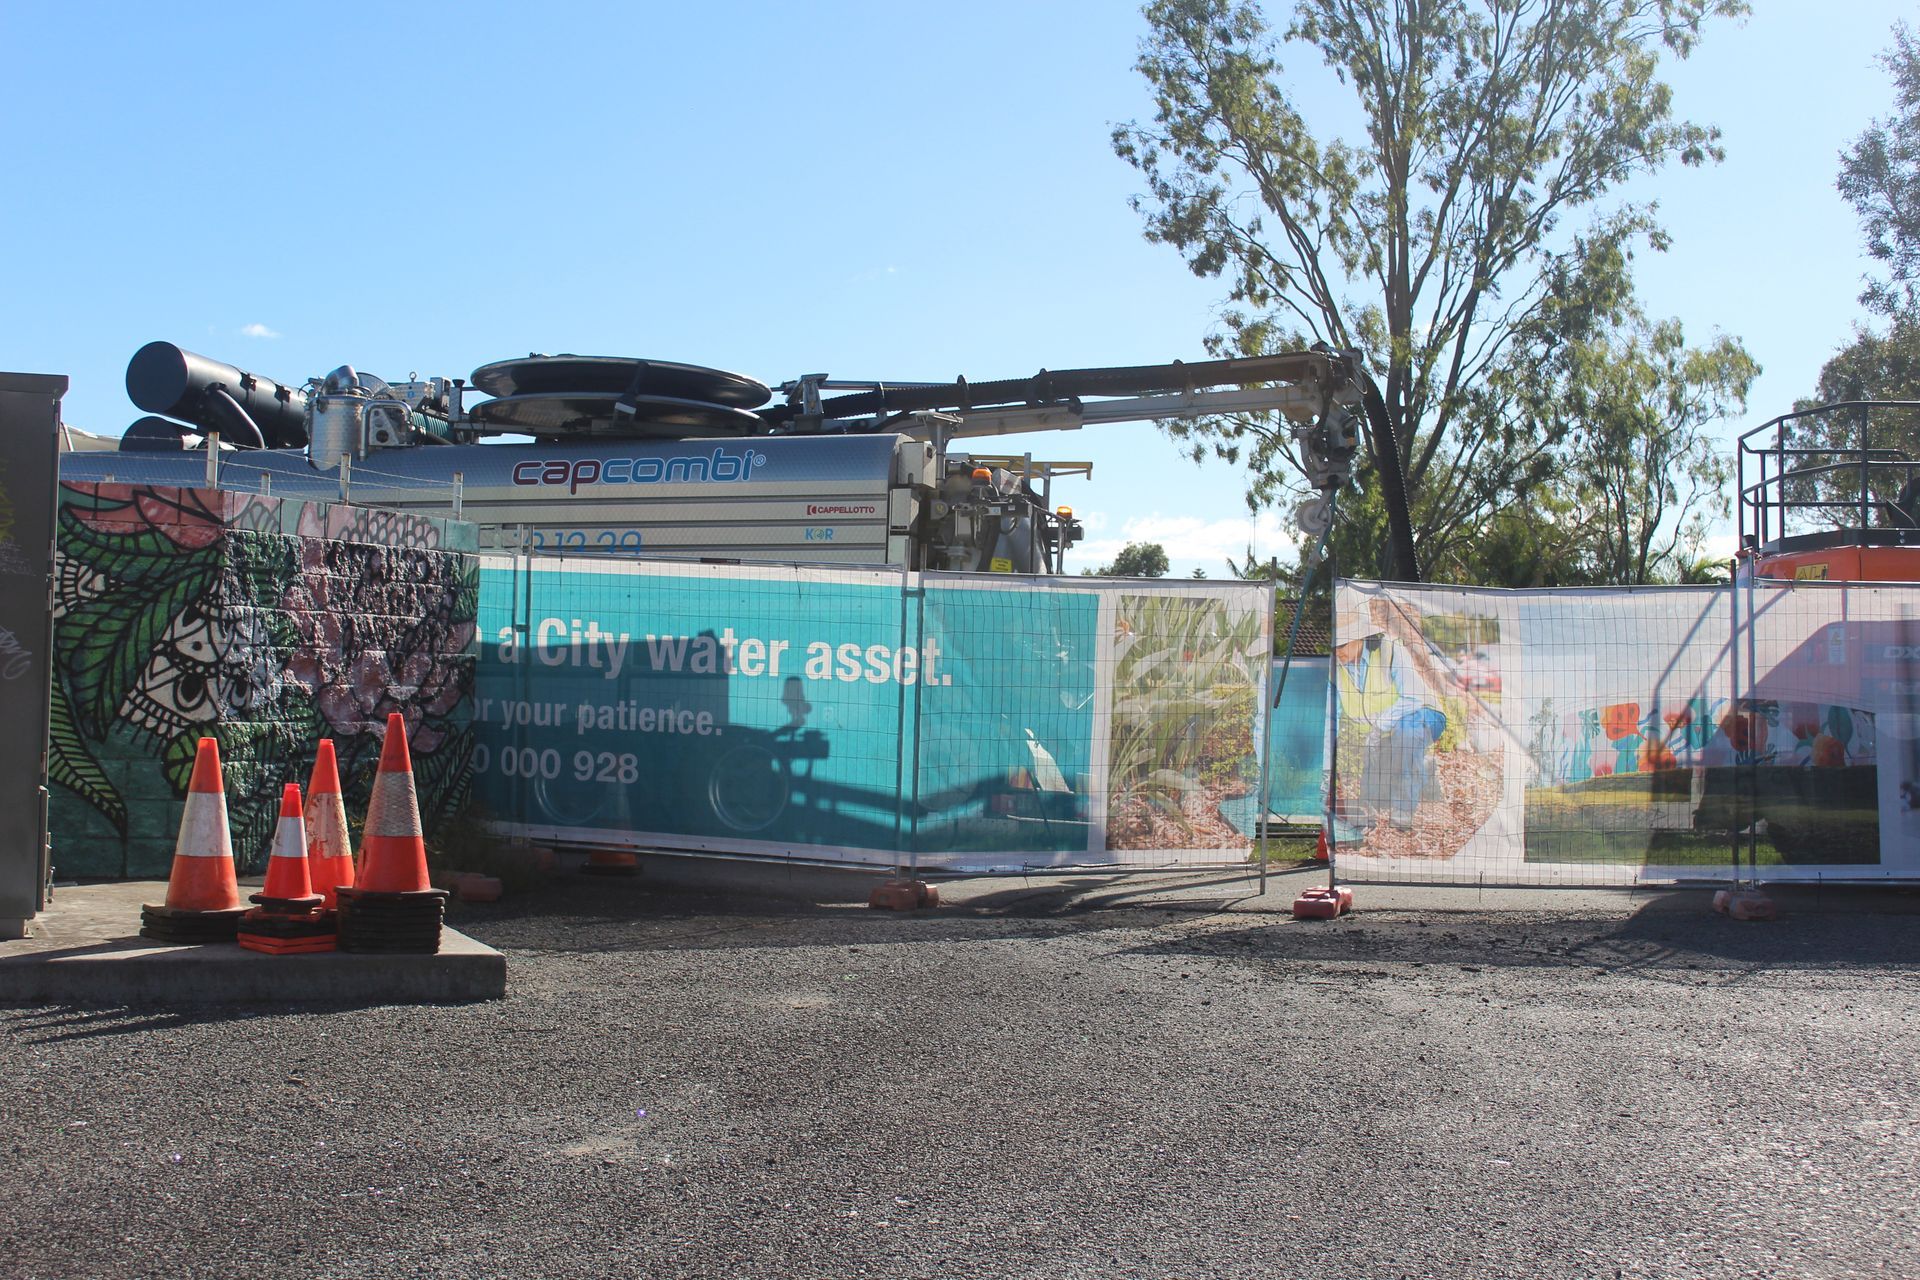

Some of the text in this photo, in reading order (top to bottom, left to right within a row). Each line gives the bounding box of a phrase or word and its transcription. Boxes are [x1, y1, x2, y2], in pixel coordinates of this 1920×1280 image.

[817, 506, 875, 514] CAPPELLOTTO
[498, 626, 519, 664] a
[537, 617, 631, 679] City
[647, 627, 788, 677] water
[805, 637, 952, 686] asset.
[501, 700, 567, 730] your
[577, 699, 722, 736] patience.
[574, 750, 639, 785] 928
